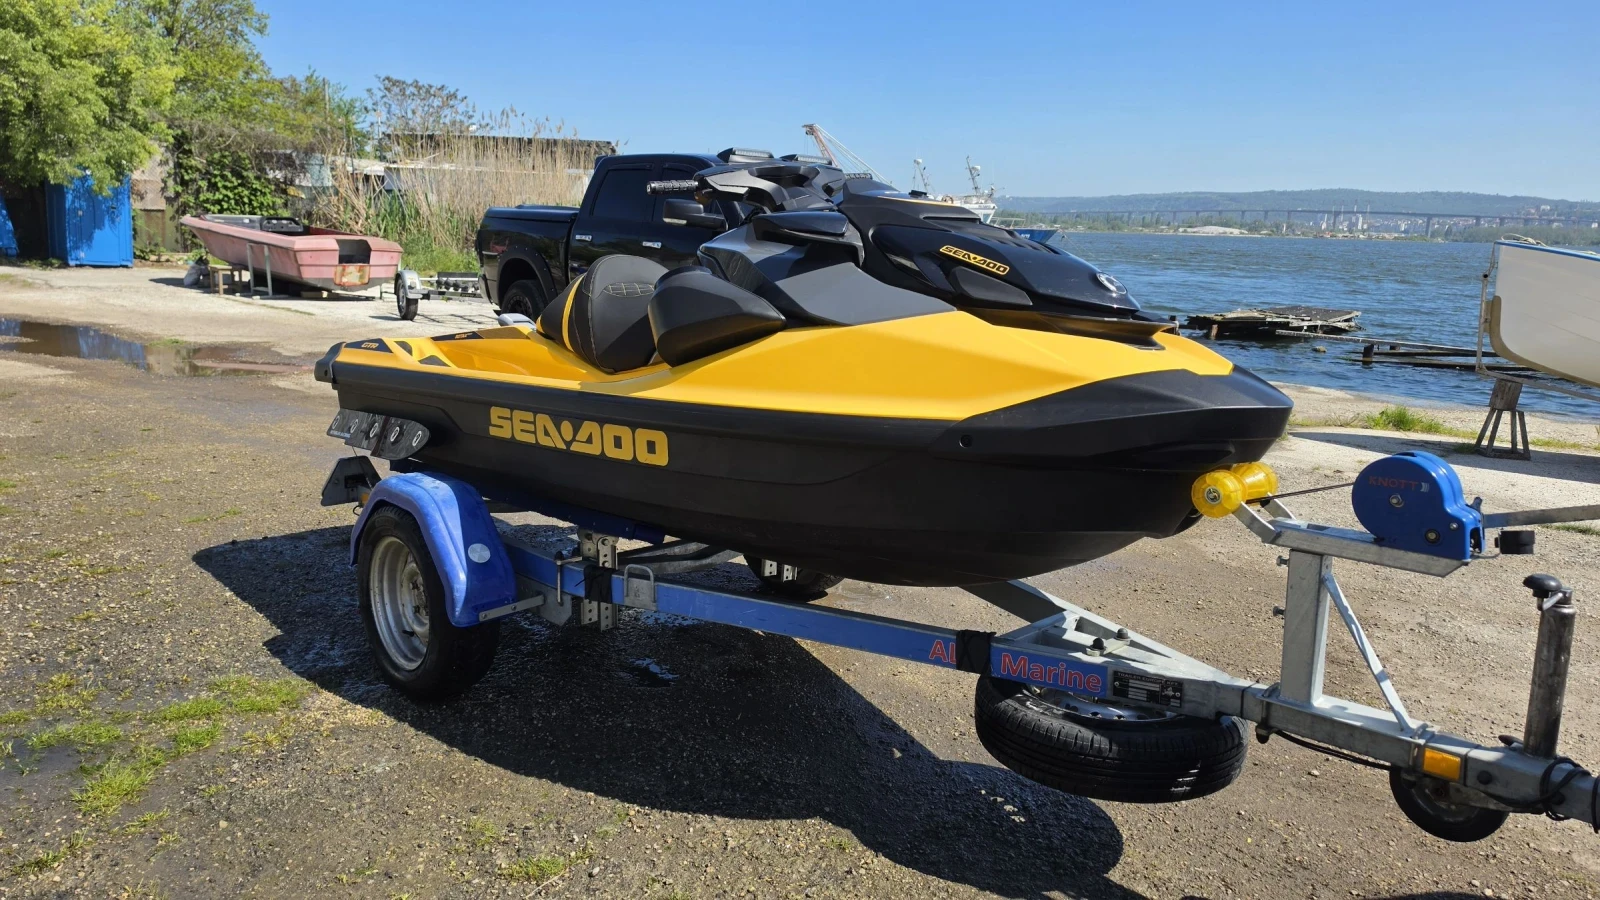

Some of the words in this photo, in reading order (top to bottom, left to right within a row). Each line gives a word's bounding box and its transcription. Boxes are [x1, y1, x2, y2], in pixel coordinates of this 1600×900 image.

[1369, 475, 1419, 491] KNOTT
[1001, 652, 1102, 692] Marine
[1117, 672, 1141, 680] TRAILER
